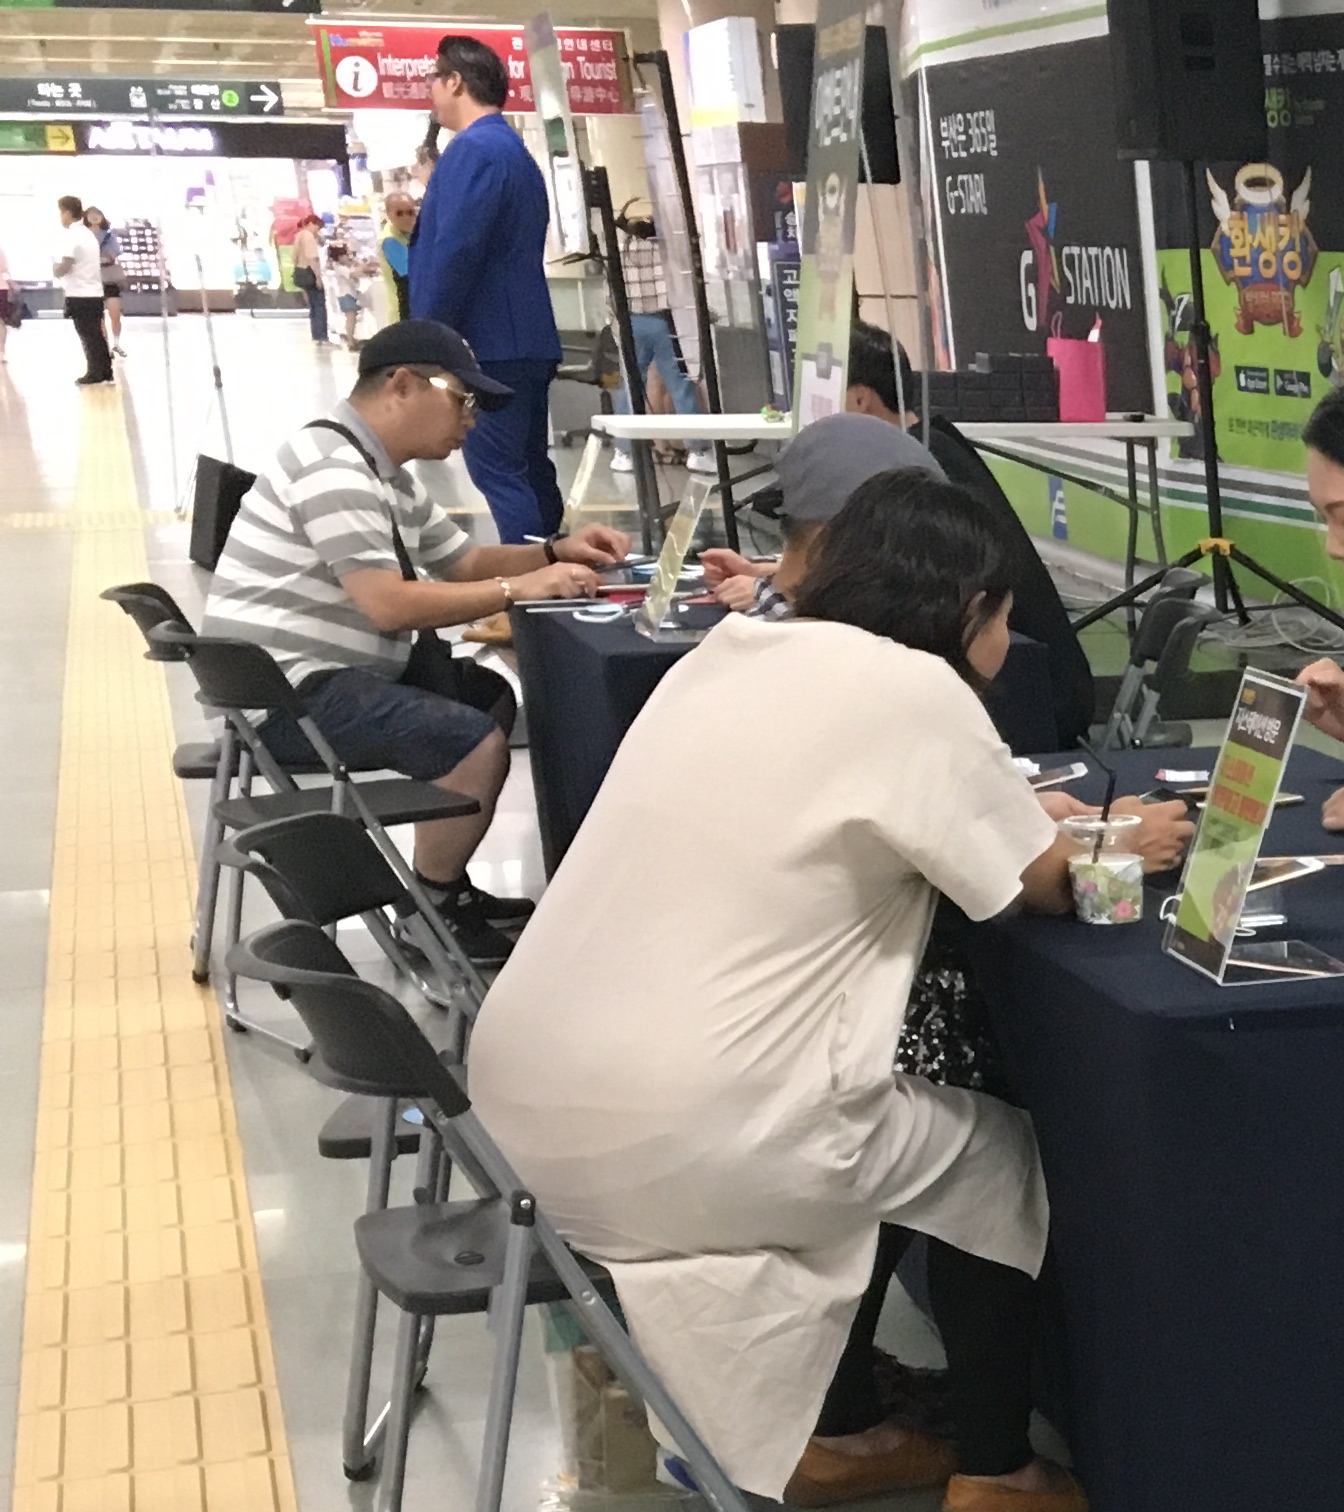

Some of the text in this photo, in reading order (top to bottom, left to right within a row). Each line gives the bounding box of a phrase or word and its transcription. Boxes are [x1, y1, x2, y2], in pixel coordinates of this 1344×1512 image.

[508, 56, 525, 79] for
[577, 57, 618, 81] Tourist
[1264, 87, 1291, 128] 생킹
[940, 108, 998, 159] 부산은 365일
[1228, 210, 1302, 280] 환생킹
[1020, 246, 1131, 331] G STATION
